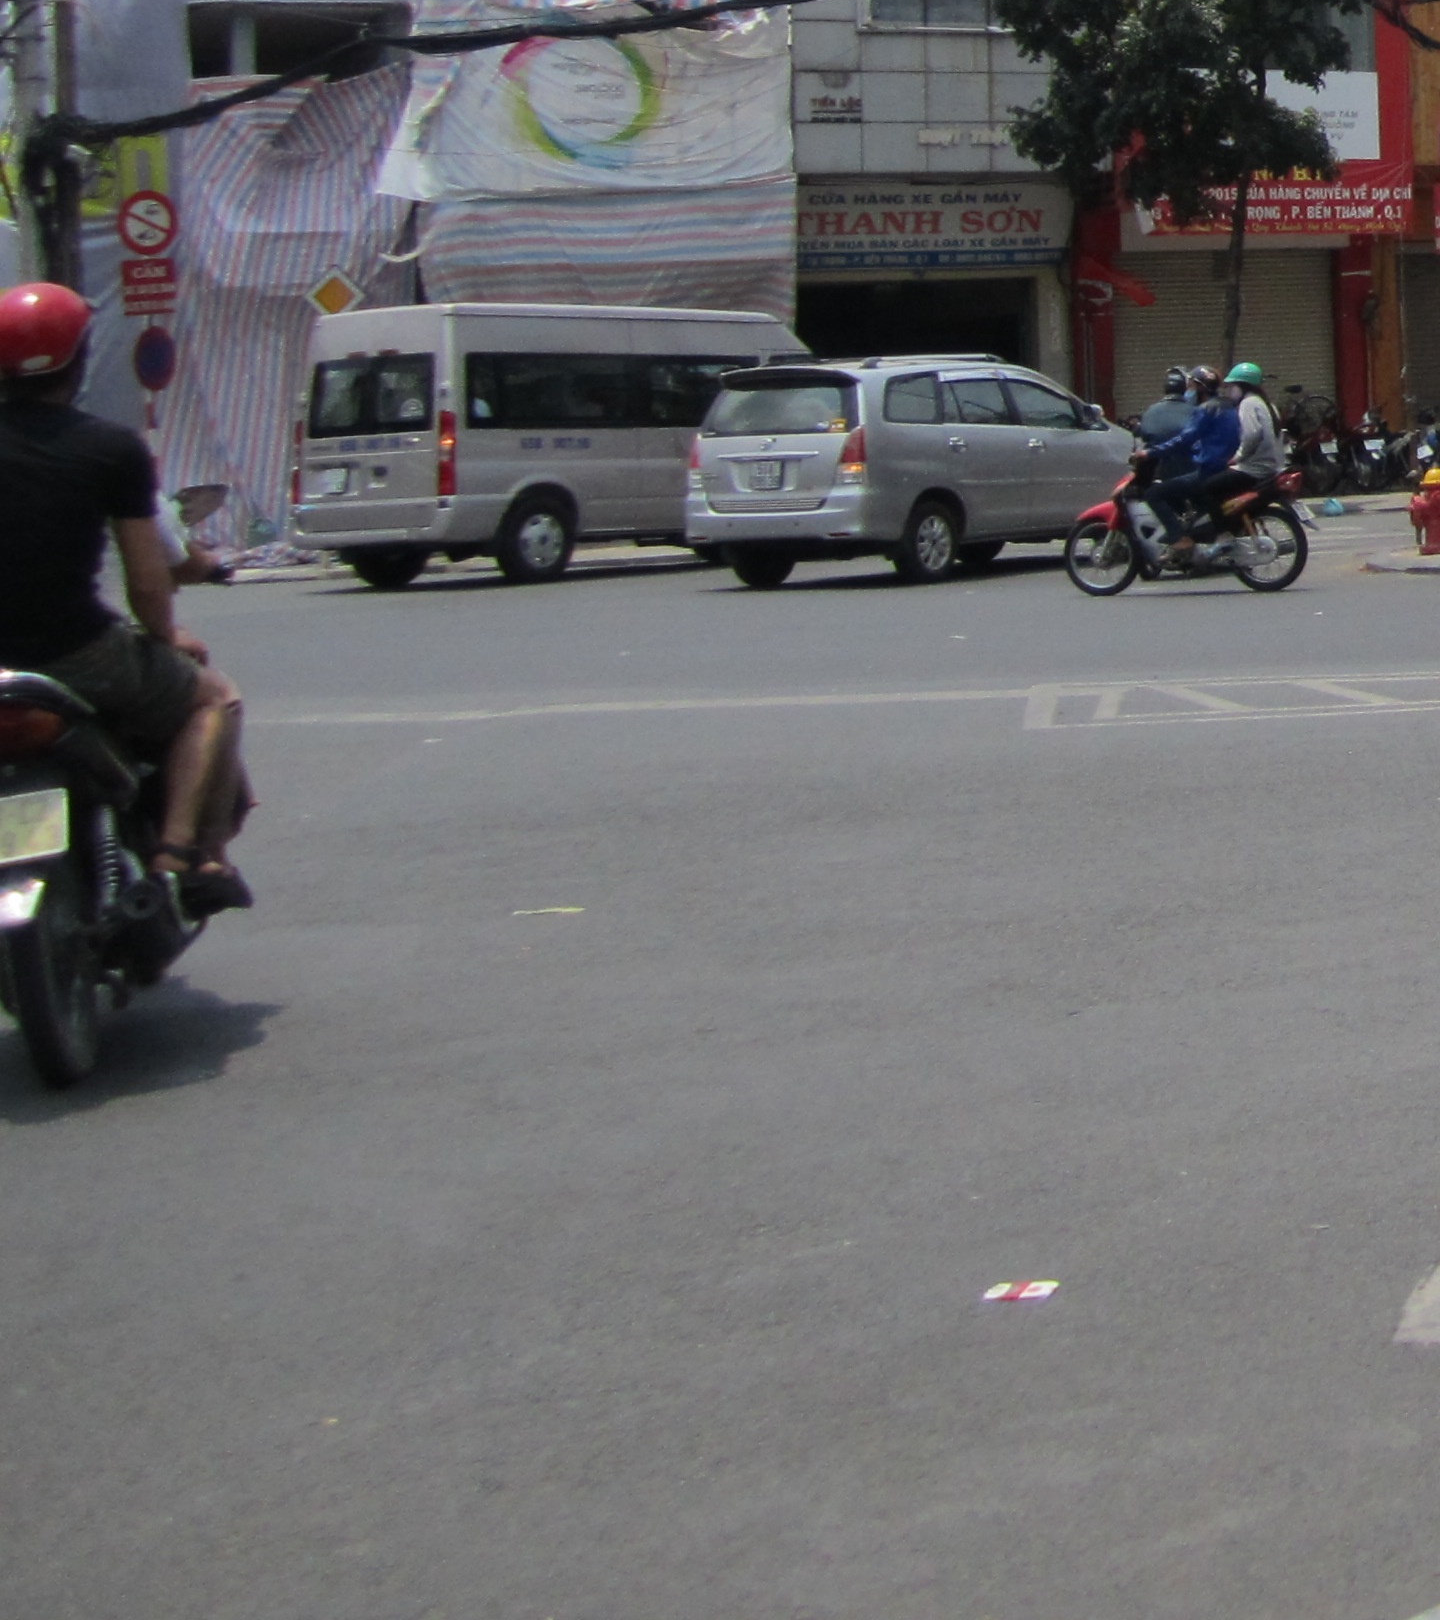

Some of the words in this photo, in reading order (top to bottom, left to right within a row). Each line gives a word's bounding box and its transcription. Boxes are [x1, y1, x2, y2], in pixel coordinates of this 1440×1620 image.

[808, 191, 846, 205] CỬA
[853, 190, 905, 205] HÀNG
[911, 193, 933, 205] XE
[1269, 181, 1301, 200] HÀNG
[960, 204, 1045, 234] SƠN
[1306, 201, 1332, 219] BẾN
[1335, 201, 1375, 219] THÀNH
